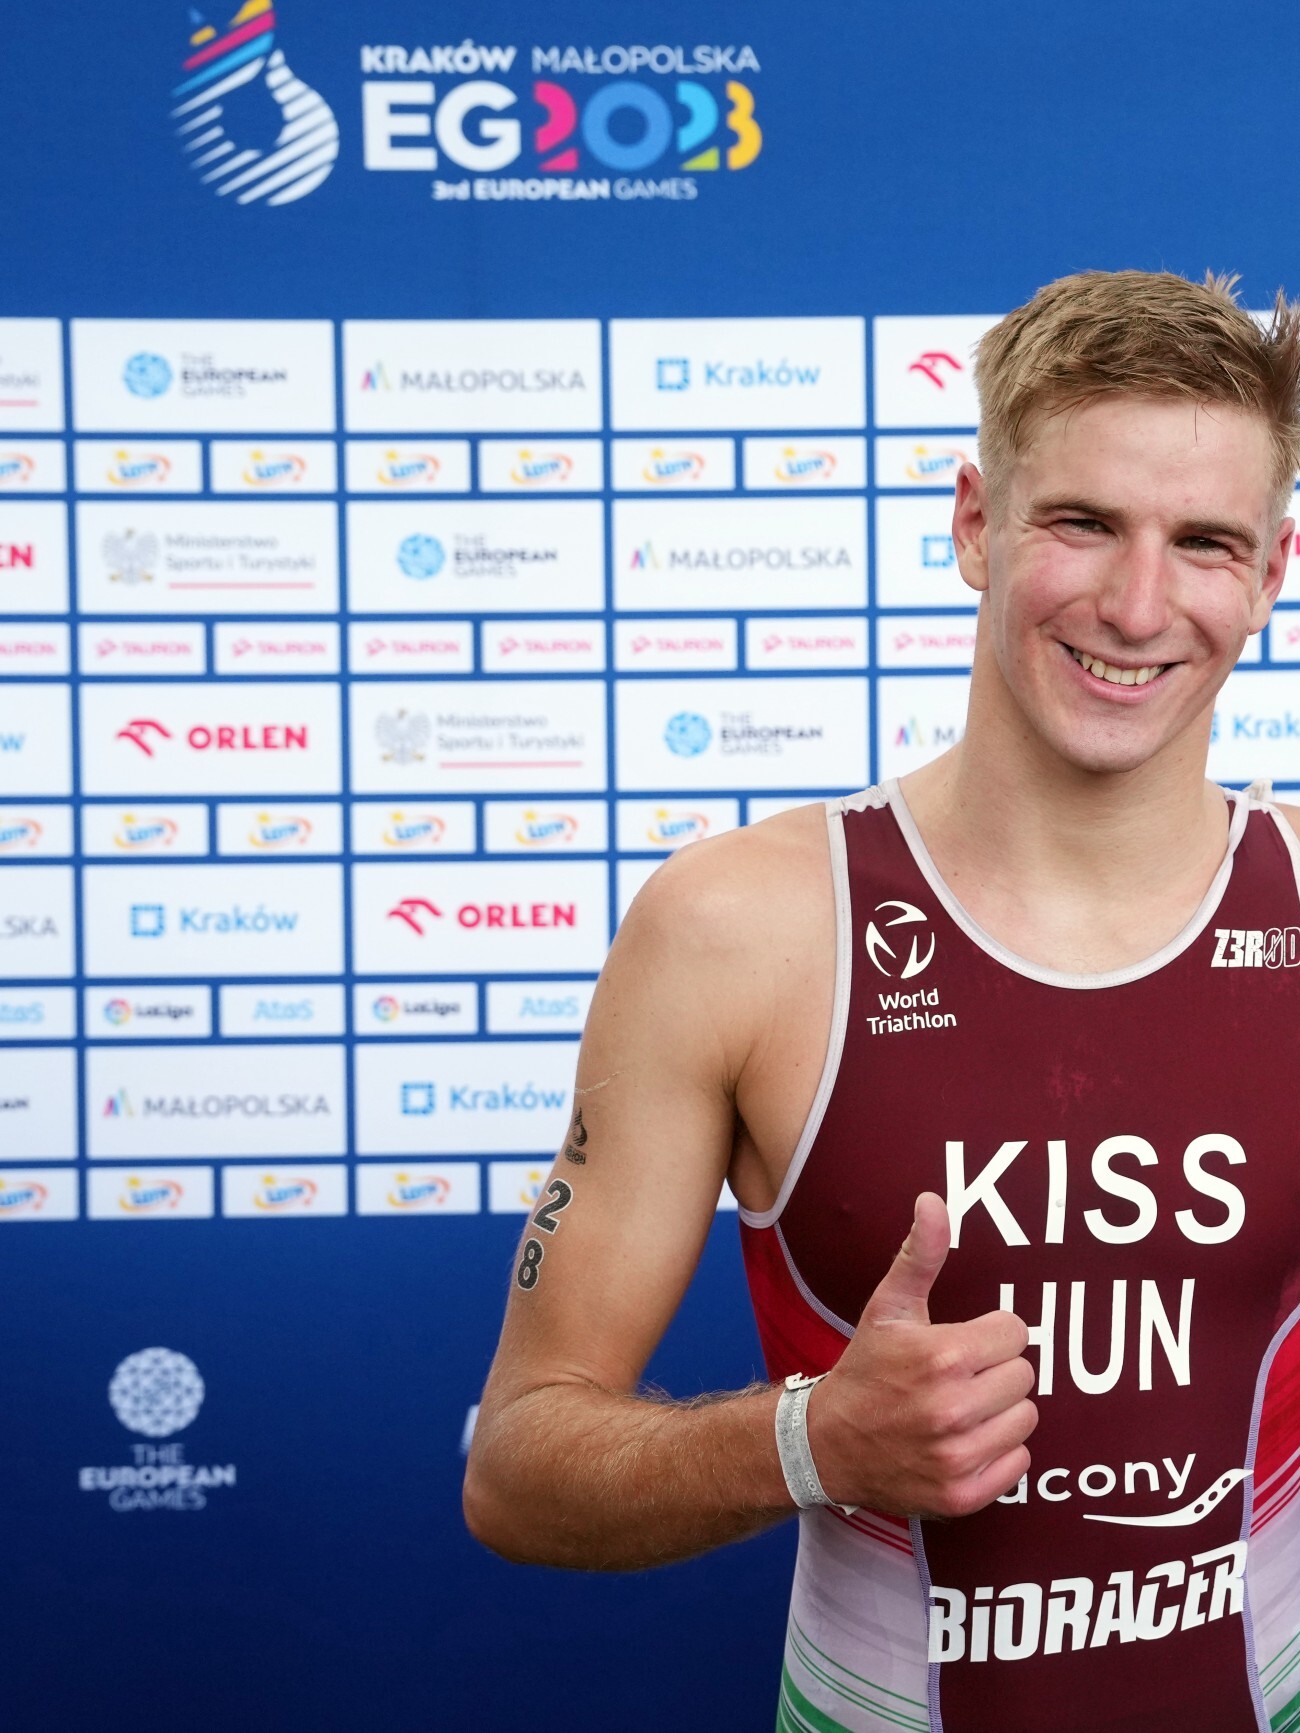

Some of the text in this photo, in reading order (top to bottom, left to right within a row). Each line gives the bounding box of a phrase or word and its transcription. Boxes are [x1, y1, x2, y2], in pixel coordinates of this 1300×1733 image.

[361, 40, 760, 73] KRAKÓW MAŁOPOLSKA
[432, 179, 697, 200] 3rd EUROPEAN GAMES
[400, 365, 586, 392] MAŁOPOLSKA
[704, 359, 820, 386] Kraków
[669, 547, 852, 571] MAŁOPOLSKA
[187, 726, 308, 750] ORLEN
[180, 904, 298, 933] Kraków
[457, 904, 577, 928] ORLEN
[878, 987, 939, 1010] World
[866, 1010, 957, 1035] Triathlon
[144, 1095, 330, 1119] MAŁOPOLSKA
[450, 1084, 566, 1112] Kraków
[946, 1133, 1247, 1248] KISS
[1000, 1278, 1195, 1396] HUN
[132, 1444, 185, 1464] THE
[79, 1465, 236, 1490] EUROPEAN
[996, 1453, 1196, 1504] ucony
[109, 1487, 206, 1511] GAMES
